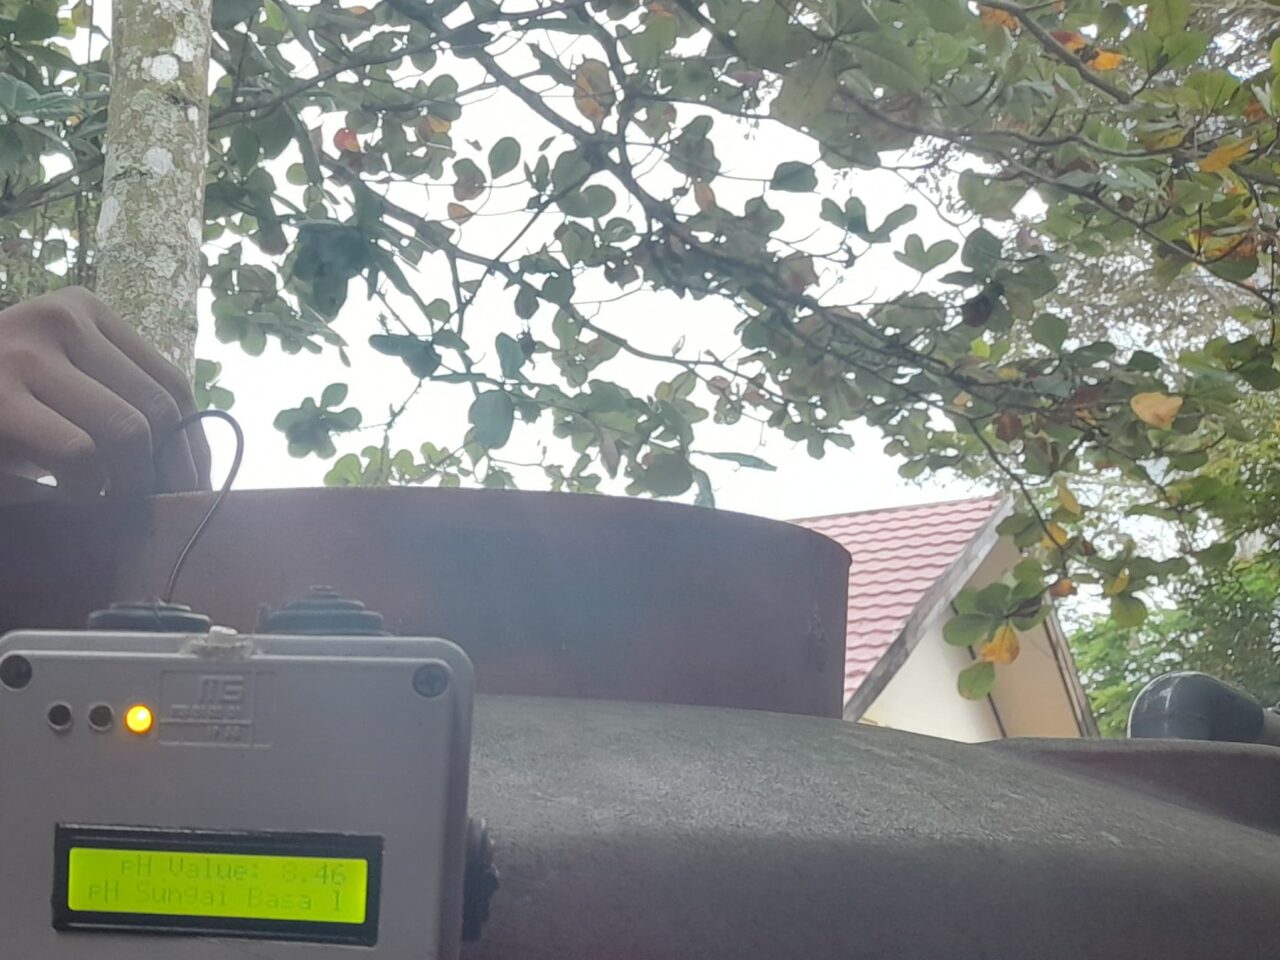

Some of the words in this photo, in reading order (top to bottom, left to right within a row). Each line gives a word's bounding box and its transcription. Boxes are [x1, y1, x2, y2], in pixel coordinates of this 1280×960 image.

[121, 855, 152, 876] pH
[169, 856, 260, 881] Value:
[281, 862, 347, 885] 8.46
[88, 880, 120, 903] pH
[135, 881, 227, 907] Sungai
[248, 887, 312, 910] Basa
